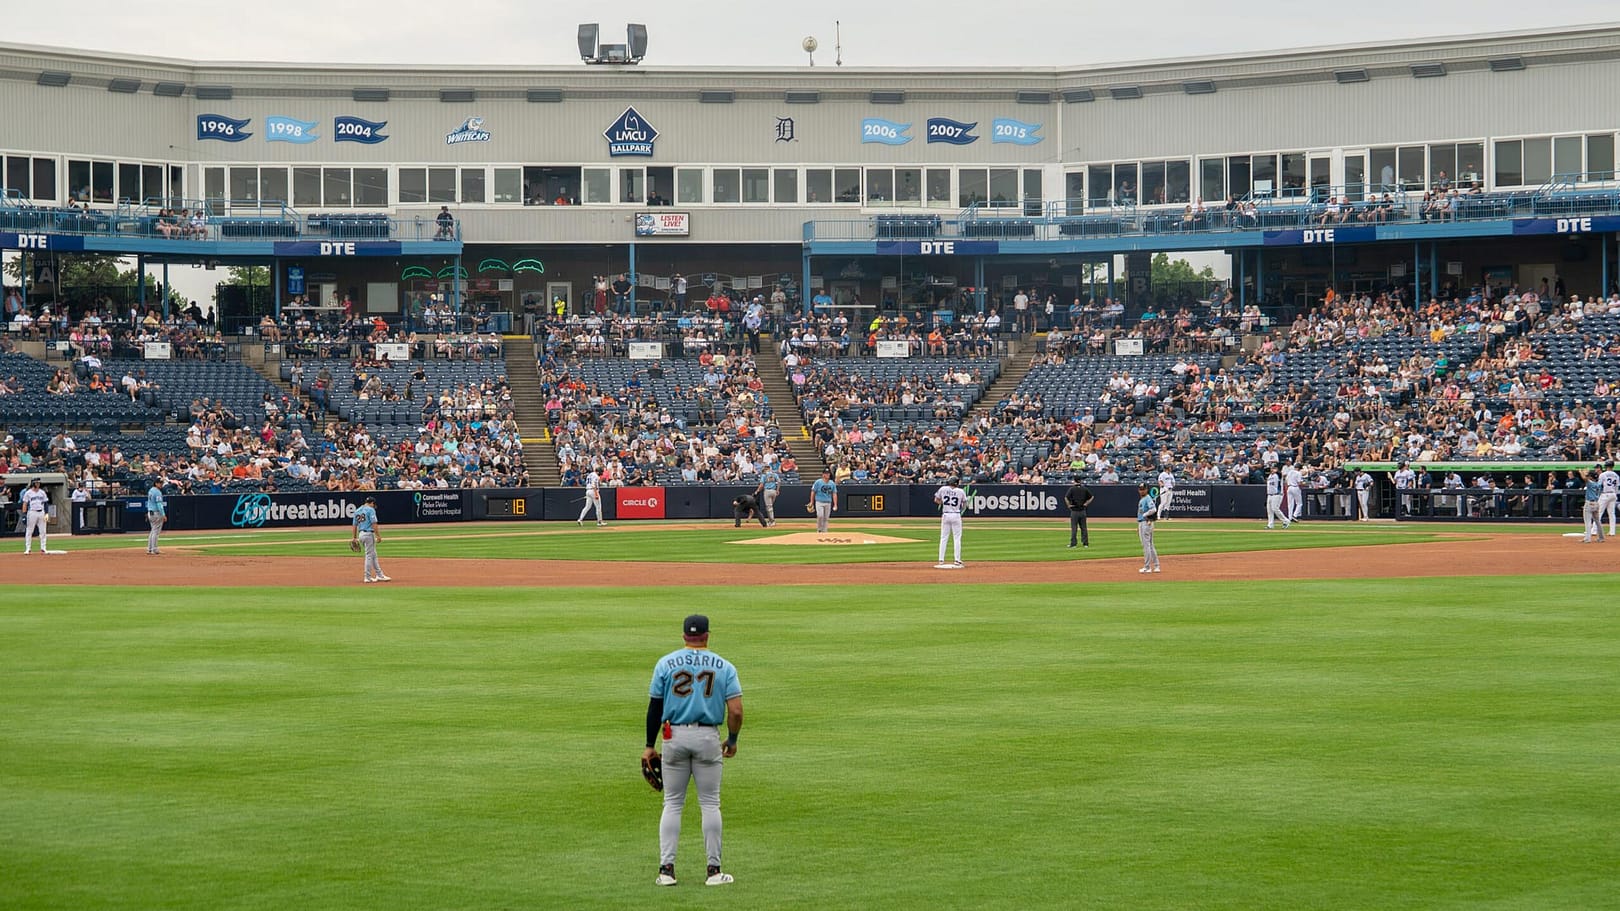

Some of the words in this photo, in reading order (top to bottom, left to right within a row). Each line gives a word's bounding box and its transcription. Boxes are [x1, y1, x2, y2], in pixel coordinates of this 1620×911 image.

[201, 121, 234, 135] 1996
[270, 123, 301, 136] 1998
[338, 123, 371, 137] 2004
[864, 125, 897, 138] 2006
[930, 125, 963, 138] 2007
[996, 125, 1026, 138] 2015
[616, 131, 647, 141] LMCU
[611, 145, 651, 153] BALLPARK
[1557, 218, 1592, 232] DTE
[18, 234, 47, 248] DTE
[1303, 229, 1334, 243] DTE
[320, 242, 355, 255] DTE
[920, 241, 954, 254] DTE
[1606, 477, 1617, 487] 34
[512, 499, 525, 515] 18
[647, 497, 658, 508] K
[871, 495, 884, 511] 18
[943, 495, 958, 506] 23
[1186, 504, 1210, 513] Hospital
[667, 655, 724, 669] ROSARIO
[672, 669, 716, 698] 27
